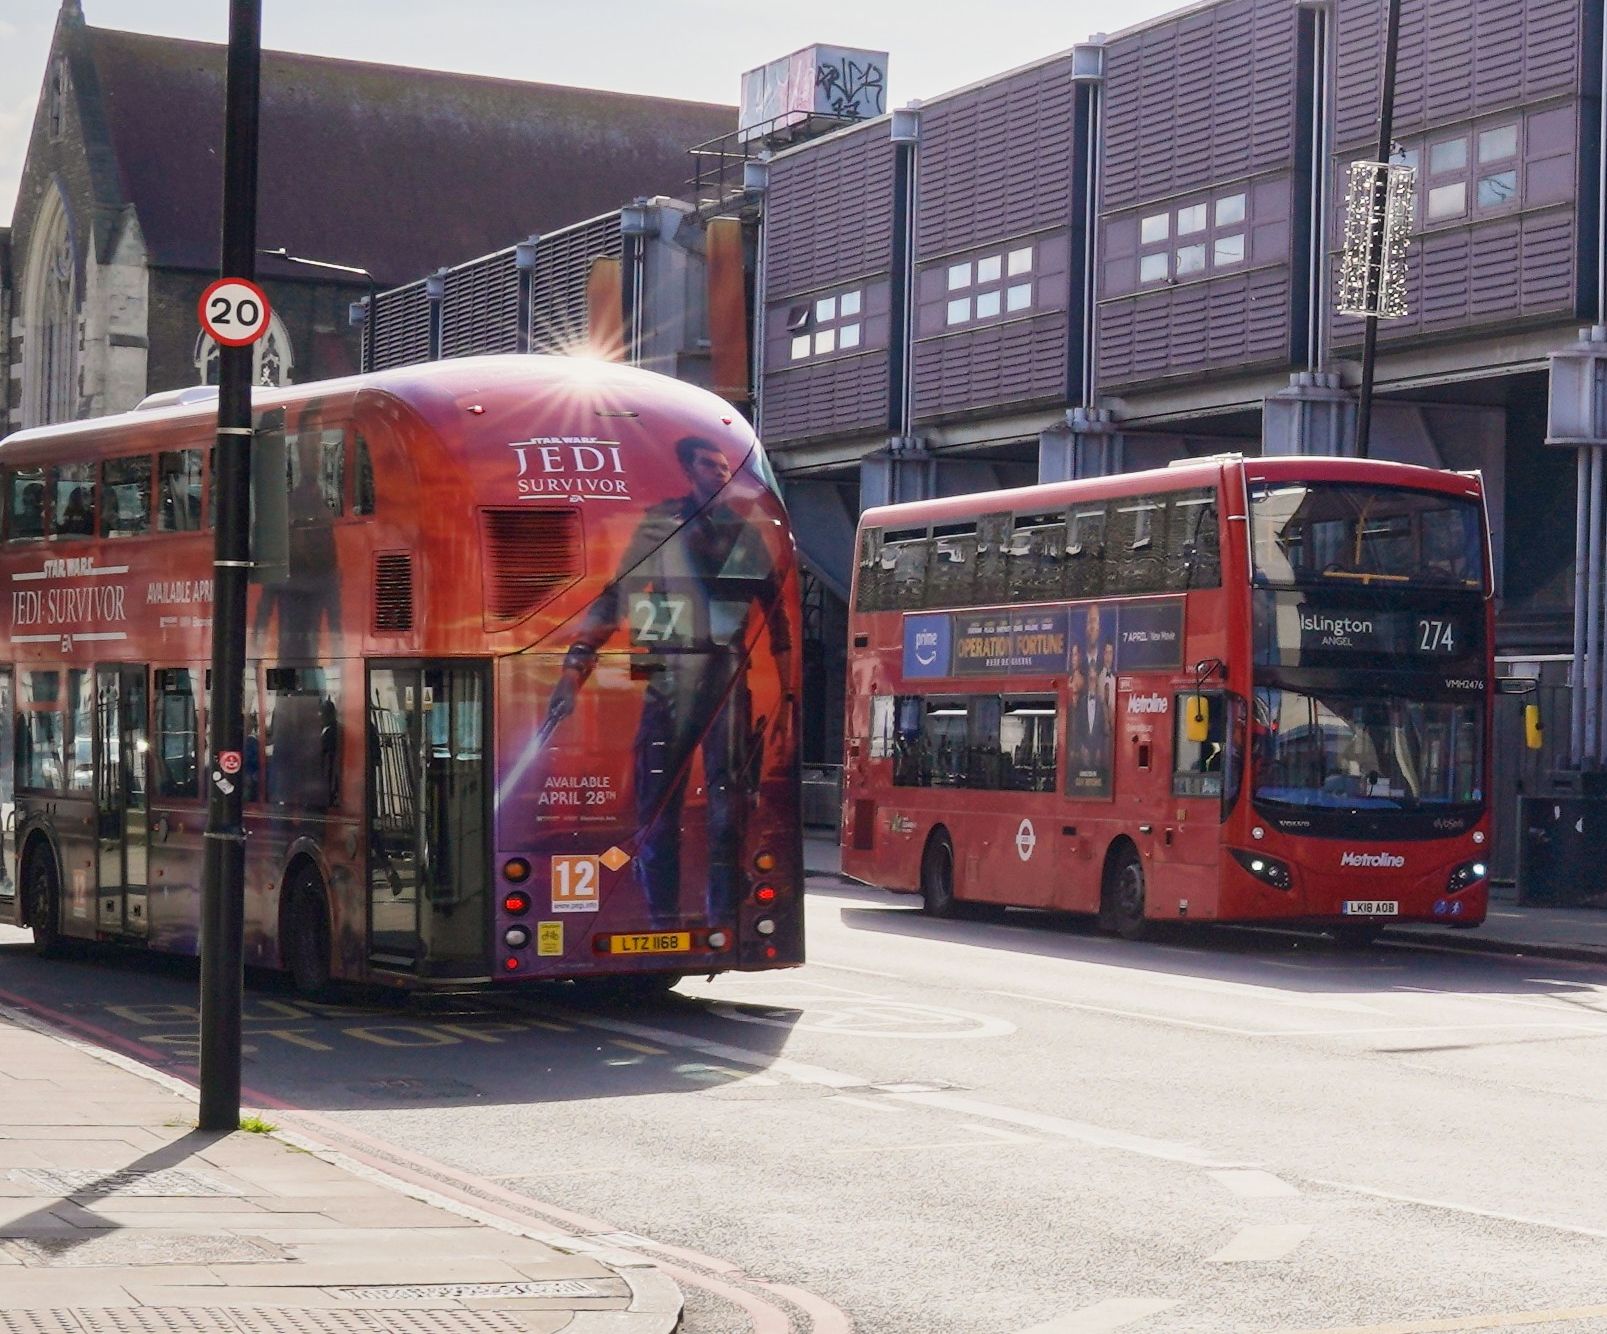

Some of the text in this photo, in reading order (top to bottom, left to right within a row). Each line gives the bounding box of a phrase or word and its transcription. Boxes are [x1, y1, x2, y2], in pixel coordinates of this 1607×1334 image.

[211, 297, 259, 327] 20
[513, 446, 626, 477] JEDI
[518, 478, 629, 493] SURVIVOR
[43, 556, 95, 578] STAR WARS
[146, 578, 214, 604] AVAILABLE APRI
[48, 584, 126, 624] SURVIVOR
[634, 600, 687, 641] 27
[1300, 613, 1373, 636] Islington
[915, 628, 938, 647] prime
[958, 633, 1064, 659] OPERATION FORTUNE
[1321, 635, 1353, 647] ANGEL
[1419, 620, 1455, 652] 274
[1445, 679, 1485, 690] VMH2476
[1126, 692, 1169, 714] Metroline
[544, 776, 610, 788] AVAILABLE
[538, 791, 581, 806] APRIL
[1340, 851, 1405, 868] Metroline
[555, 860, 595, 896] 12
[1350, 902, 1373, 913] LK18
[621, 935, 679, 951] LTZ 1168
